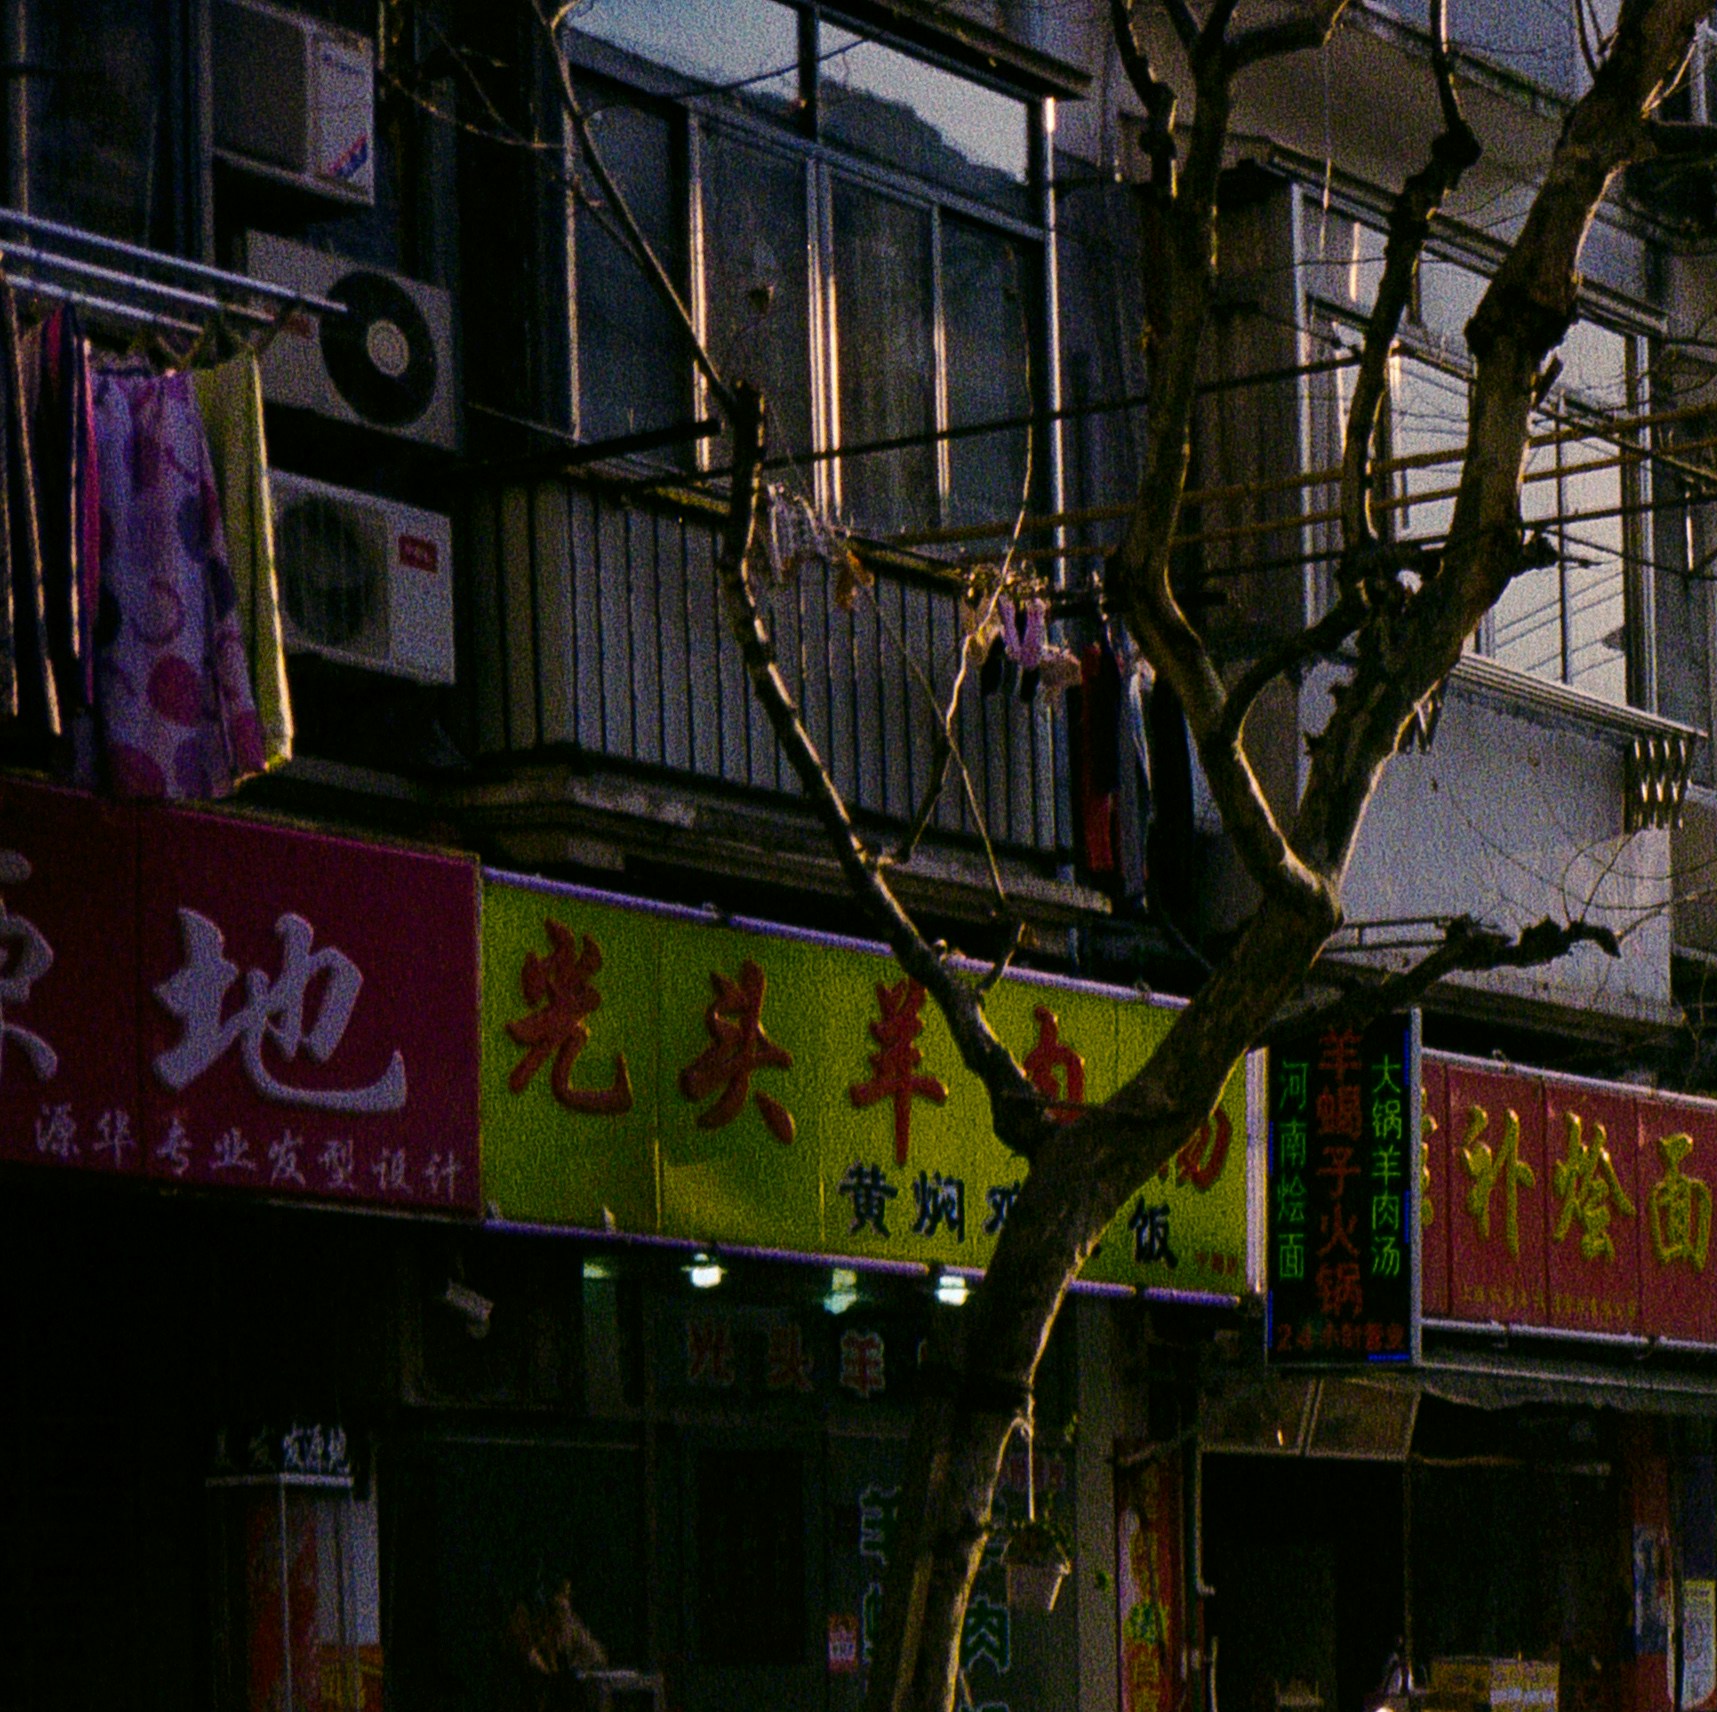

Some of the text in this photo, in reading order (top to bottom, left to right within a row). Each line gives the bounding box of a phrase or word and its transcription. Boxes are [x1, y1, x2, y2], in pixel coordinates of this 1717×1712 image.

[836, 1160, 1178, 1268] 黄焖饭
[1278, 1060, 1309, 1279] 河南烩面
[1315, 1026, 1363, 1318] 羊蝎子火锅
[1371, 1054, 1402, 1277] 大锅羊肉汤
[1420, 1087, 1712, 1273] 补烩面
[687, 1317, 929, 1398] 光头羊
